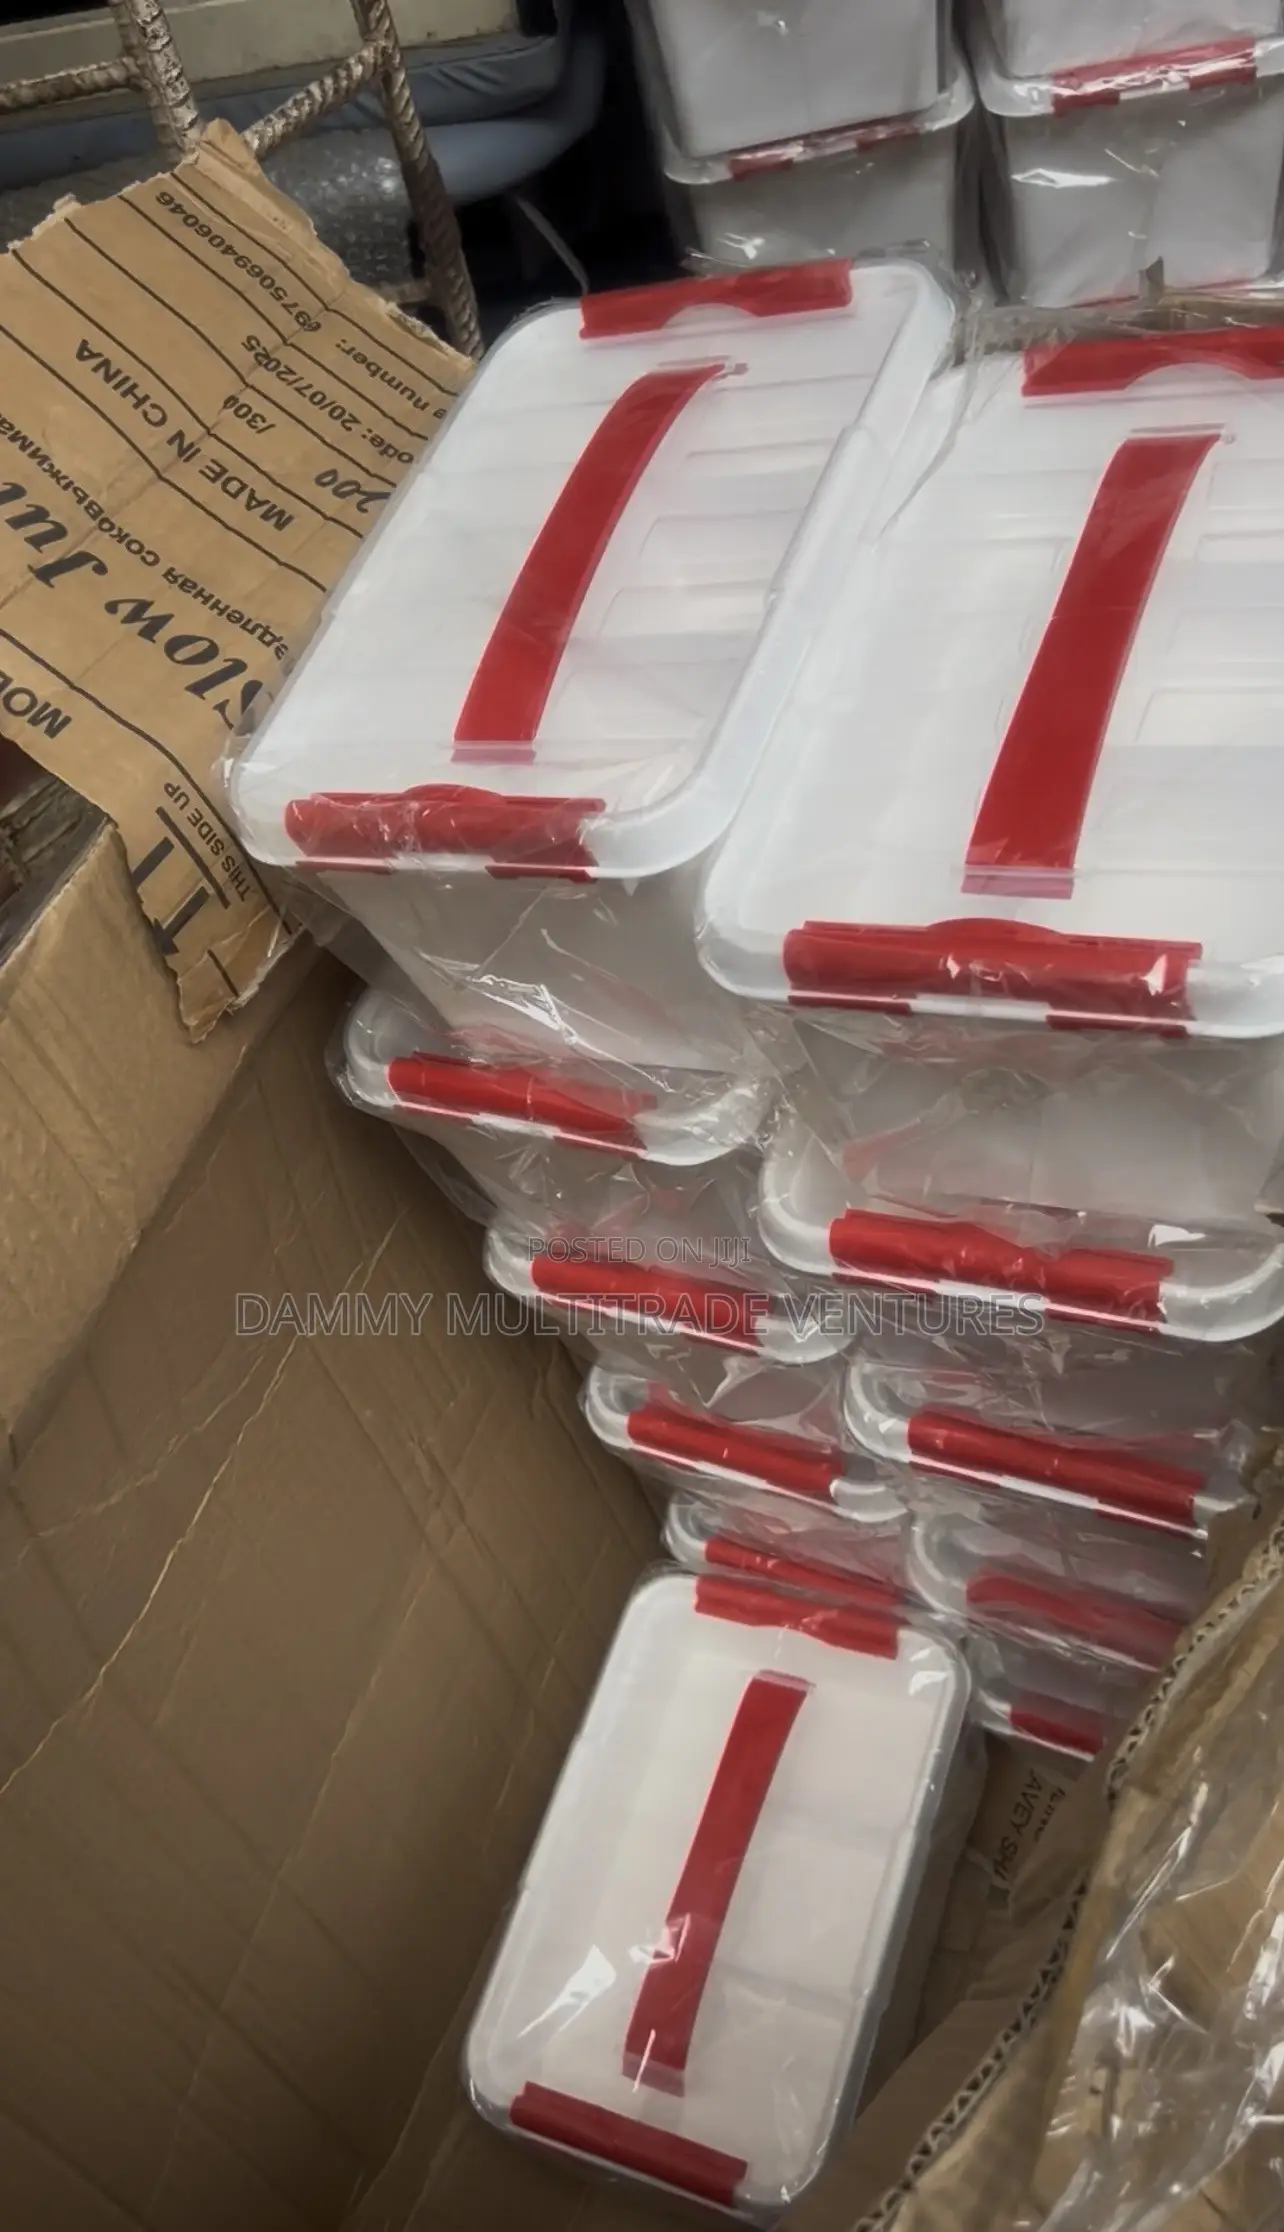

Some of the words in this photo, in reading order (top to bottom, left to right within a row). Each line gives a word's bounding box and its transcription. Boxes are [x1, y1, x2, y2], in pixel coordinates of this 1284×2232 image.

[76, 339, 168, 428] CHINA
[241, 335, 362, 432] 20/07/2025
[335, 338, 430, 412] number:
[166, 429, 202, 464] IN
[198, 458, 295, 532] MADE
[162, 567, 290, 662] едленная
[164, 782, 191, 811] UP
[186, 807, 225, 856] SIDE
[221, 855, 251, 902] THIS
